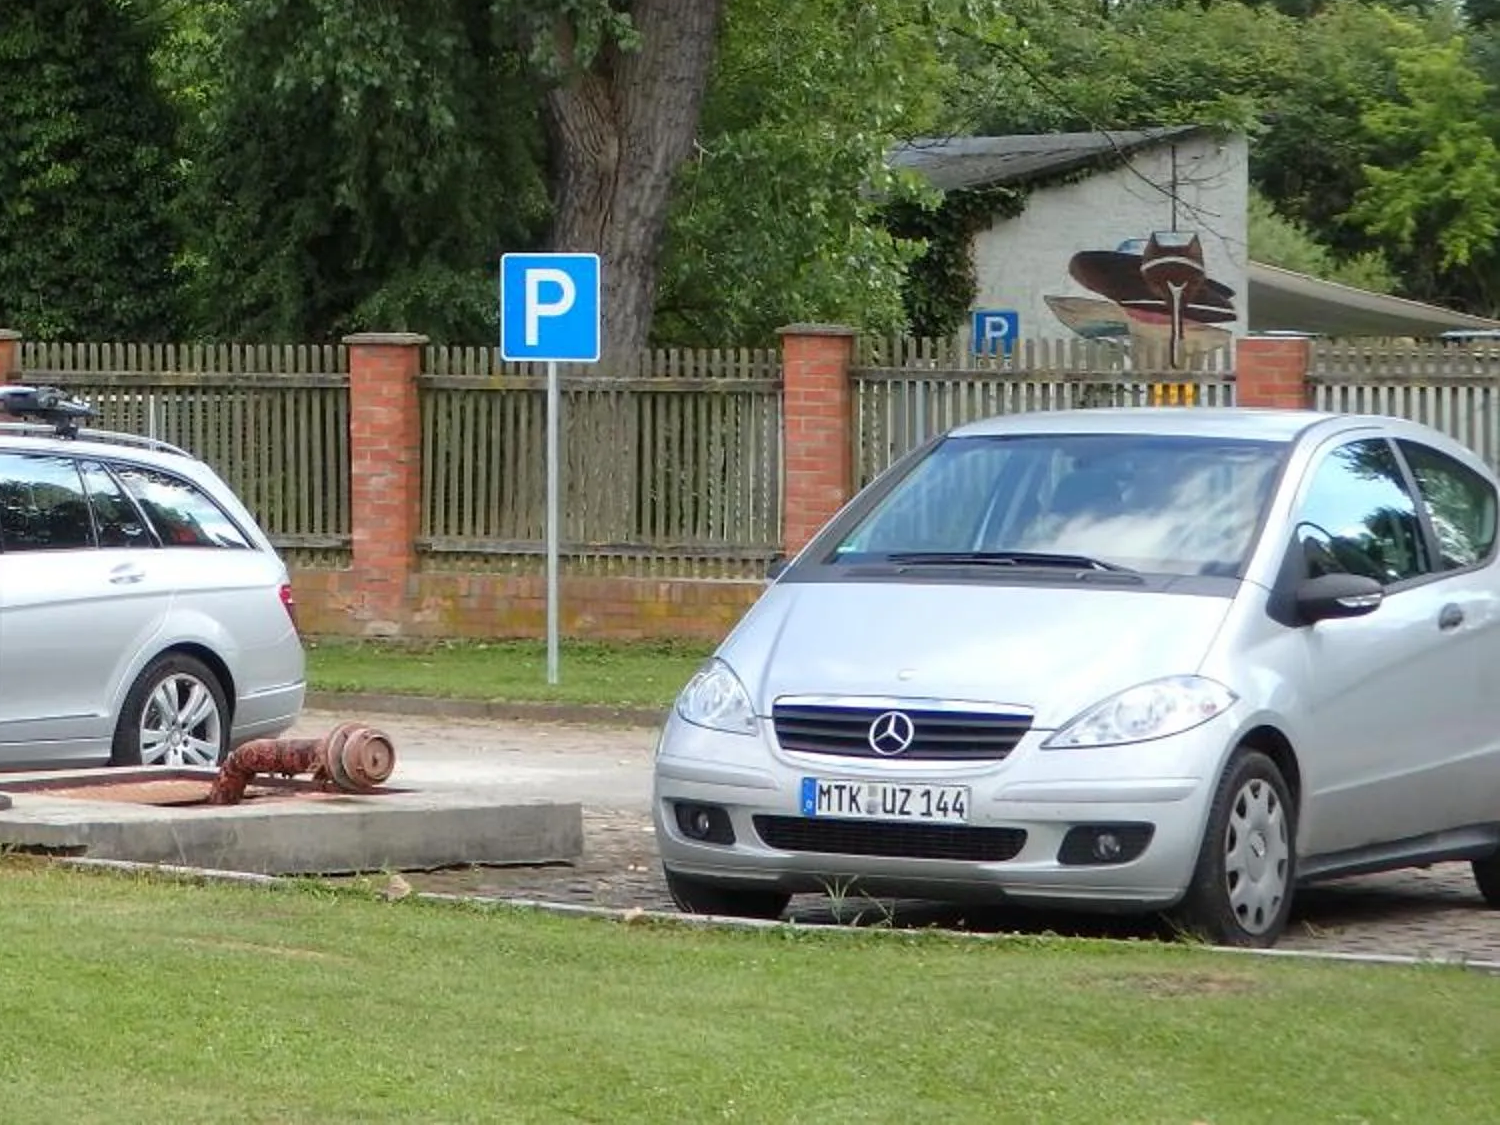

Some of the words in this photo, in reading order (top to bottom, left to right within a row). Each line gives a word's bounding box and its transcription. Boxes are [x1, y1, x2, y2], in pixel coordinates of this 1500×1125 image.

[525, 268, 576, 346] P
[985, 316, 1008, 351] P
[818, 784, 862, 813] MTK
[883, 786, 912, 816] UZ
[920, 788, 966, 818] 144
